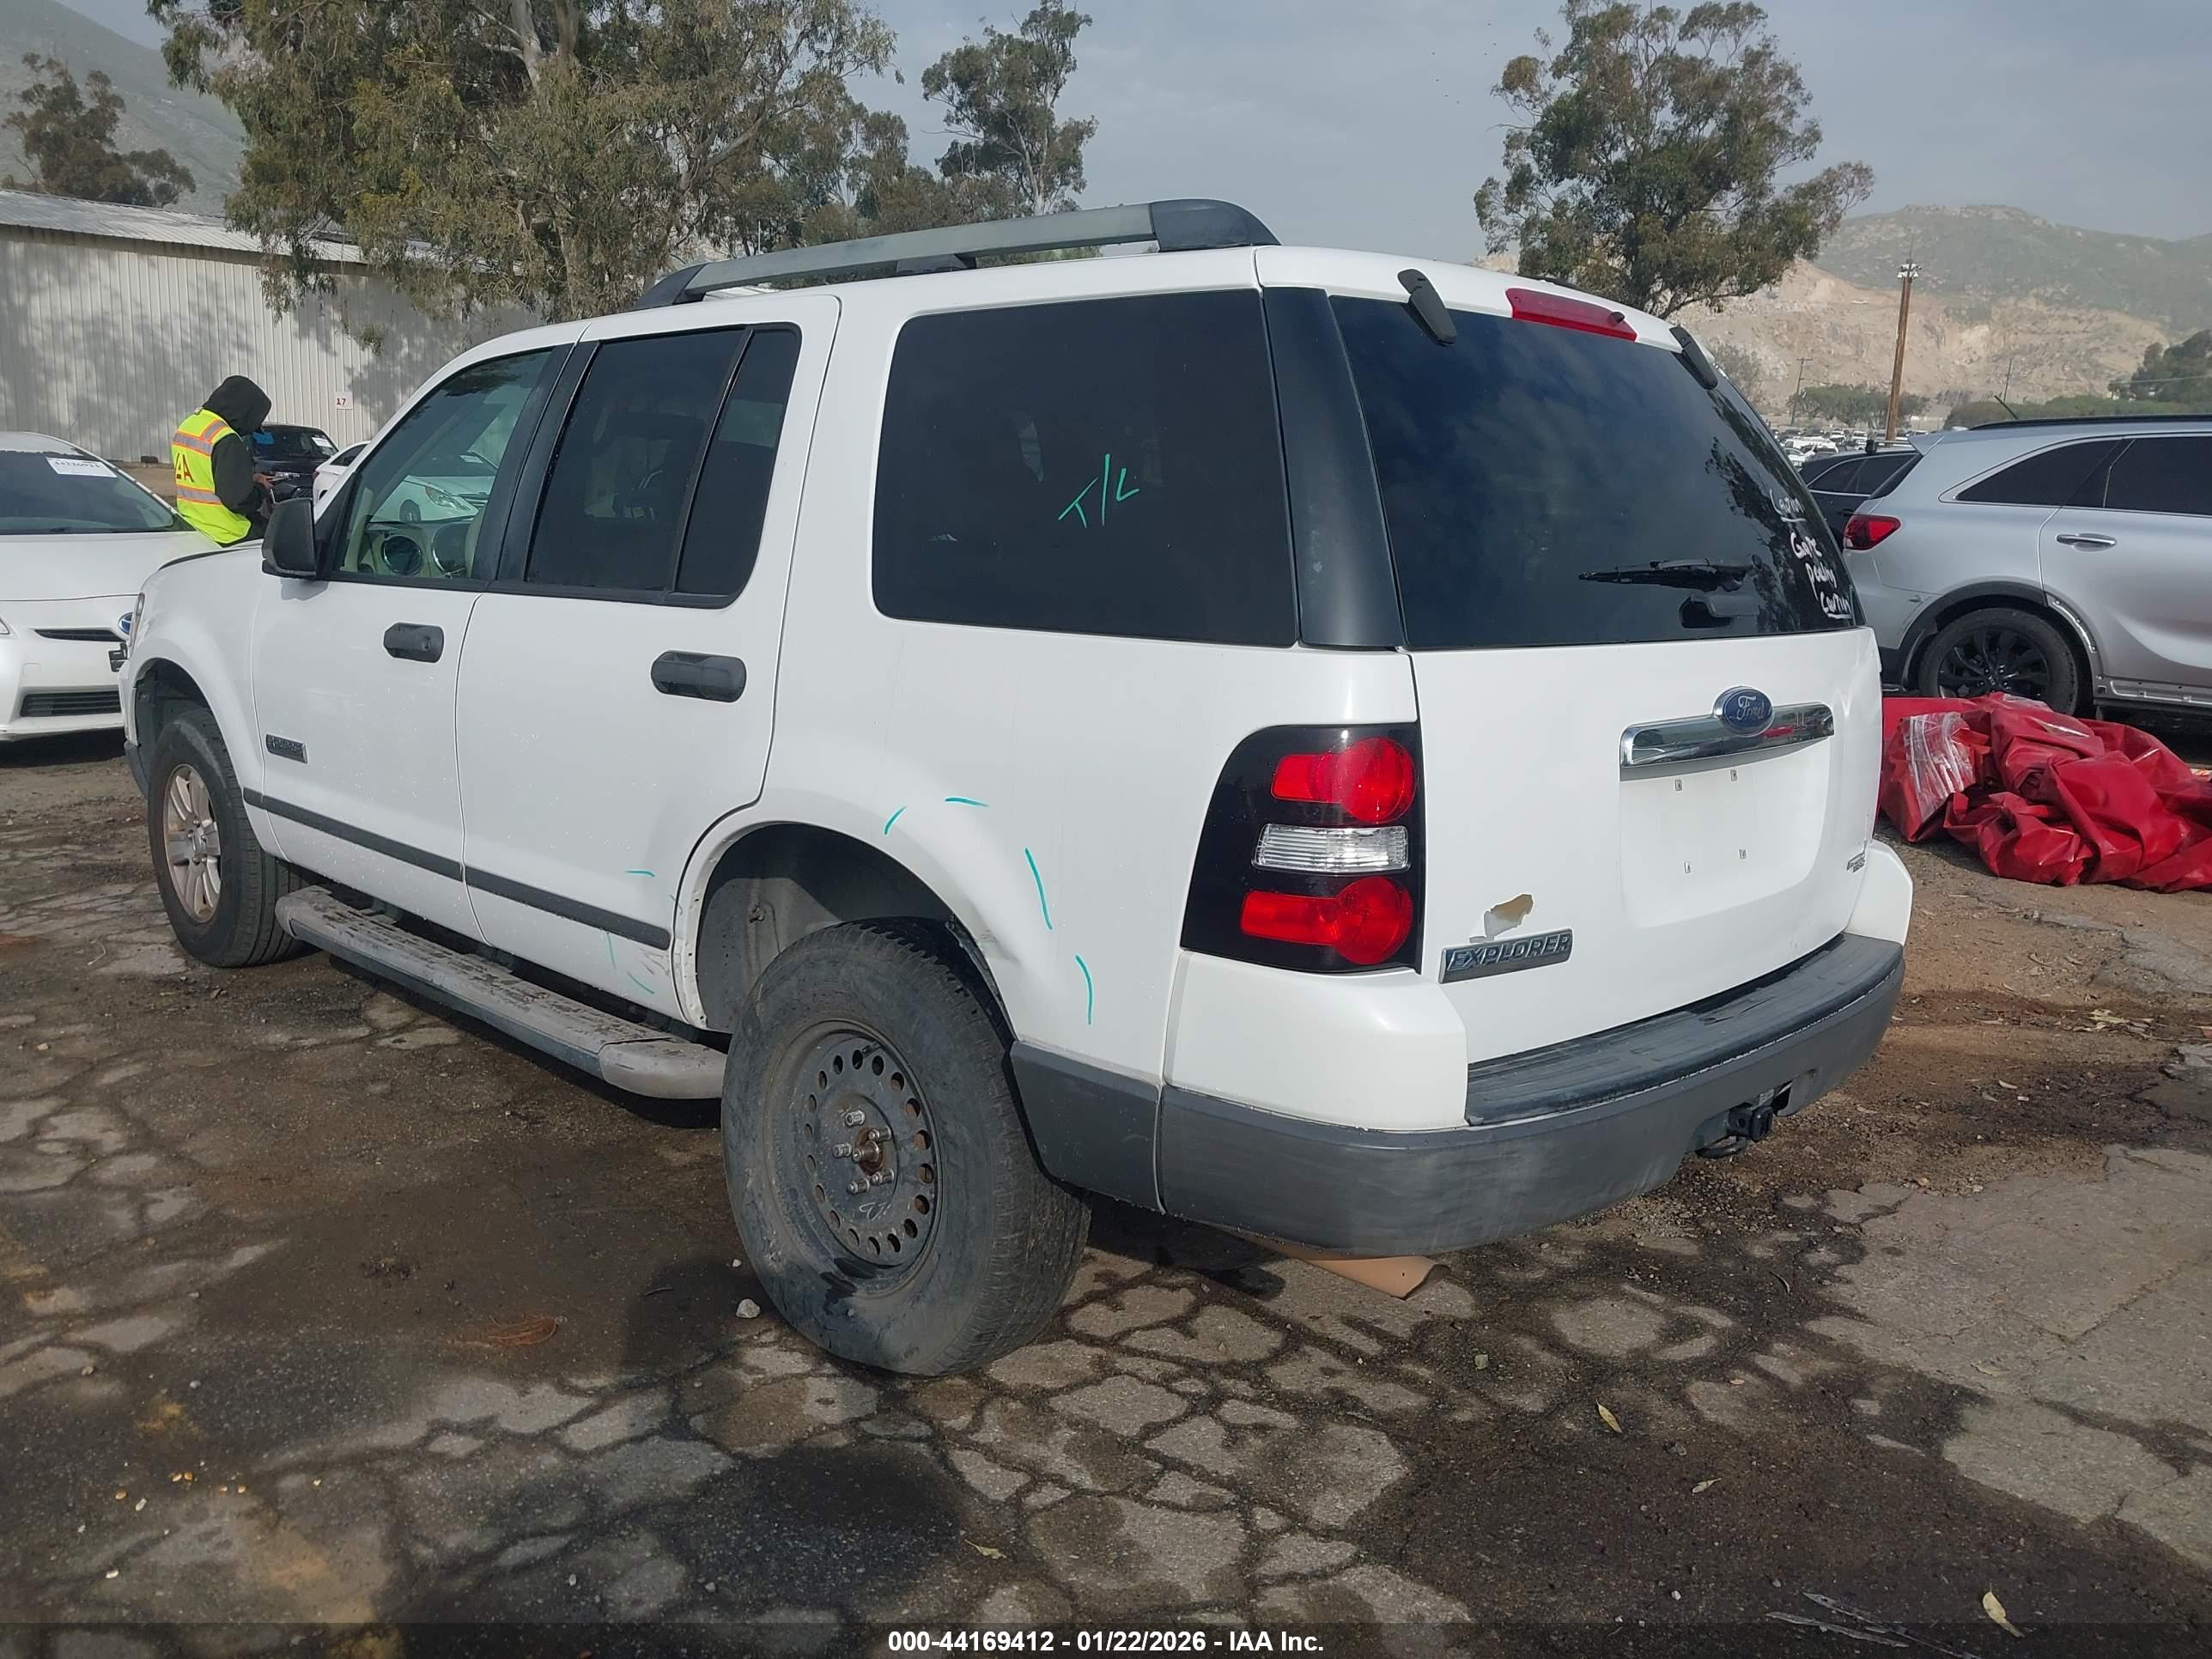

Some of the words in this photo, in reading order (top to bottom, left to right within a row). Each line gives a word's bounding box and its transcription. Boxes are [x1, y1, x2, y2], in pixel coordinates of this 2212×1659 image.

[336, 398, 347, 406] 17
[1736, 695, 1765, 721] Ford
[1446, 933, 1571, 972] EXPLORER
